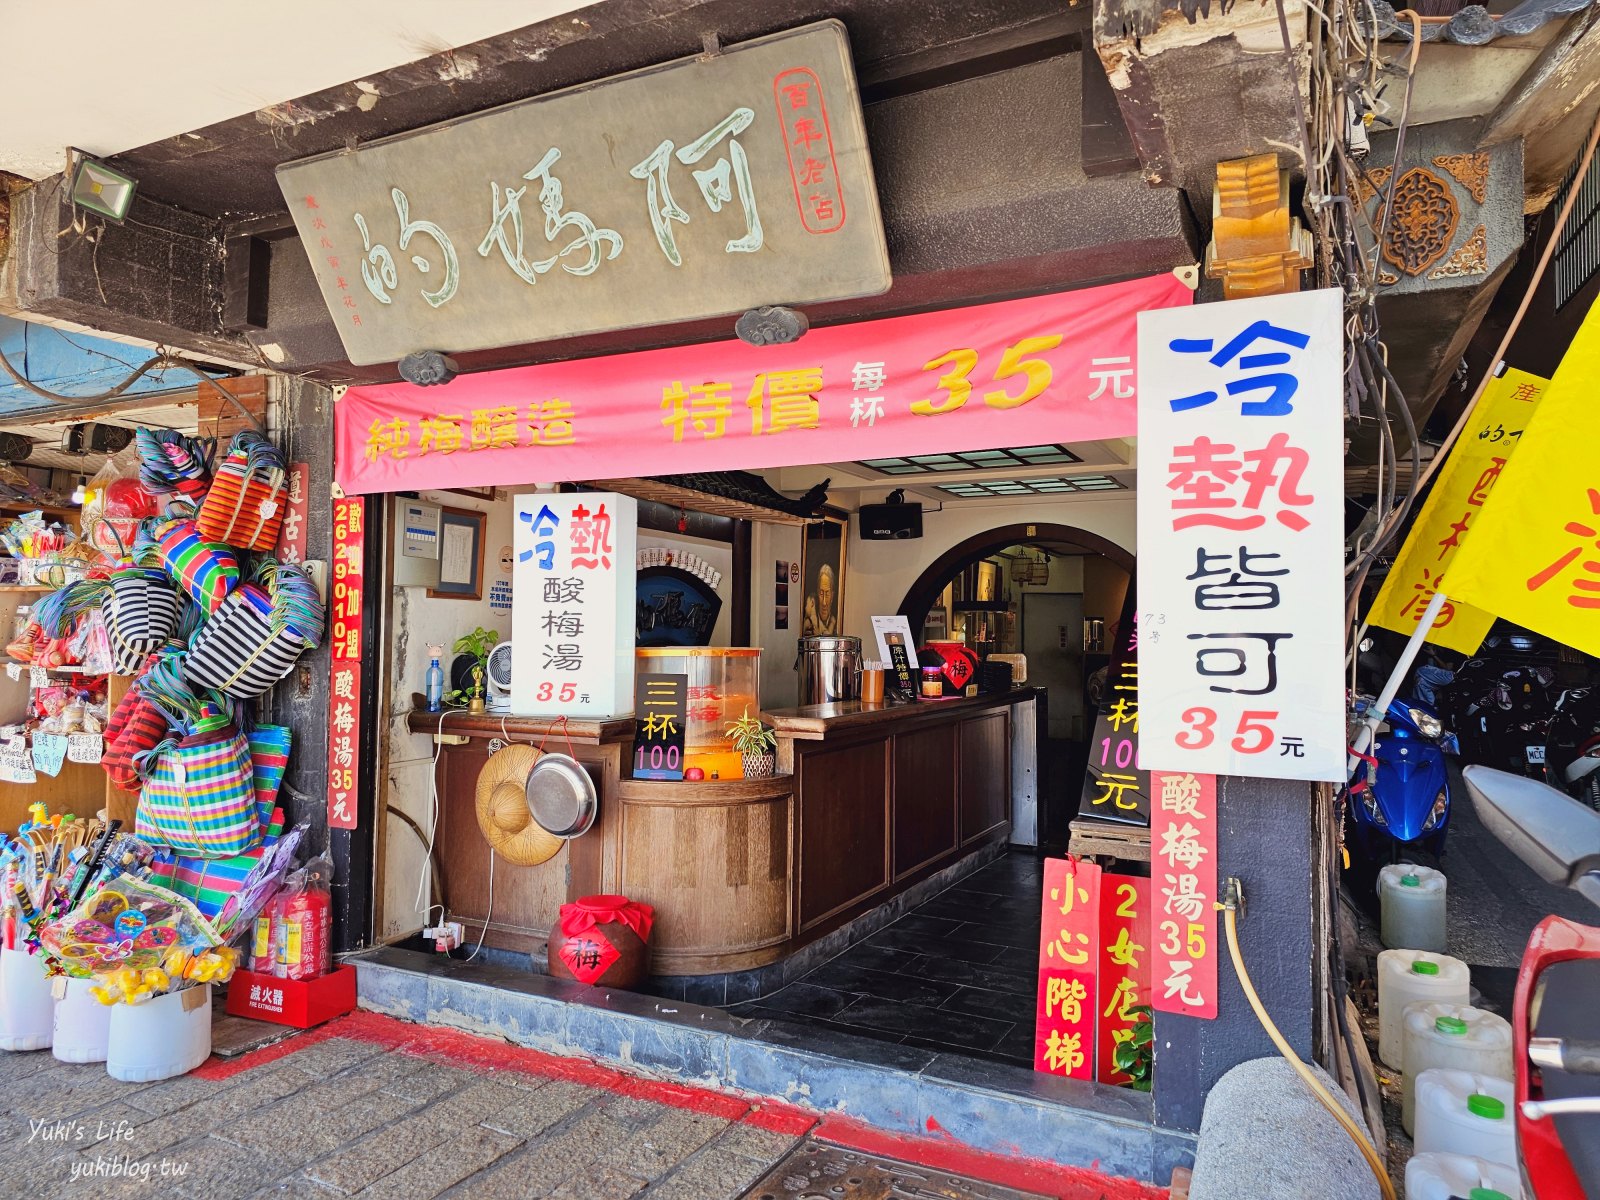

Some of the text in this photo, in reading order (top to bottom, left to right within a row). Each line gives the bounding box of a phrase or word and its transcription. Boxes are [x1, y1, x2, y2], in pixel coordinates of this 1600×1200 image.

[354, 107, 763, 308] 阿媽的
[782, 81, 834, 222] 百年老店
[364, 333, 1135, 465] 純梅釀造 特價 每杯 35 元
[334, 504, 348, 659] 26290107
[346, 502, 362, 658] 歡迎加盟
[541, 576, 585, 671] 酸梅湯
[950, 659, 968, 679] 梅
[1092, 772, 1140, 810] 元
[1101, 736, 1138, 769] 10
[249, 985, 284, 1005] 滅火器
[570, 938, 602, 970] 梅
[1043, 872, 1089, 1077] 小心階梯
